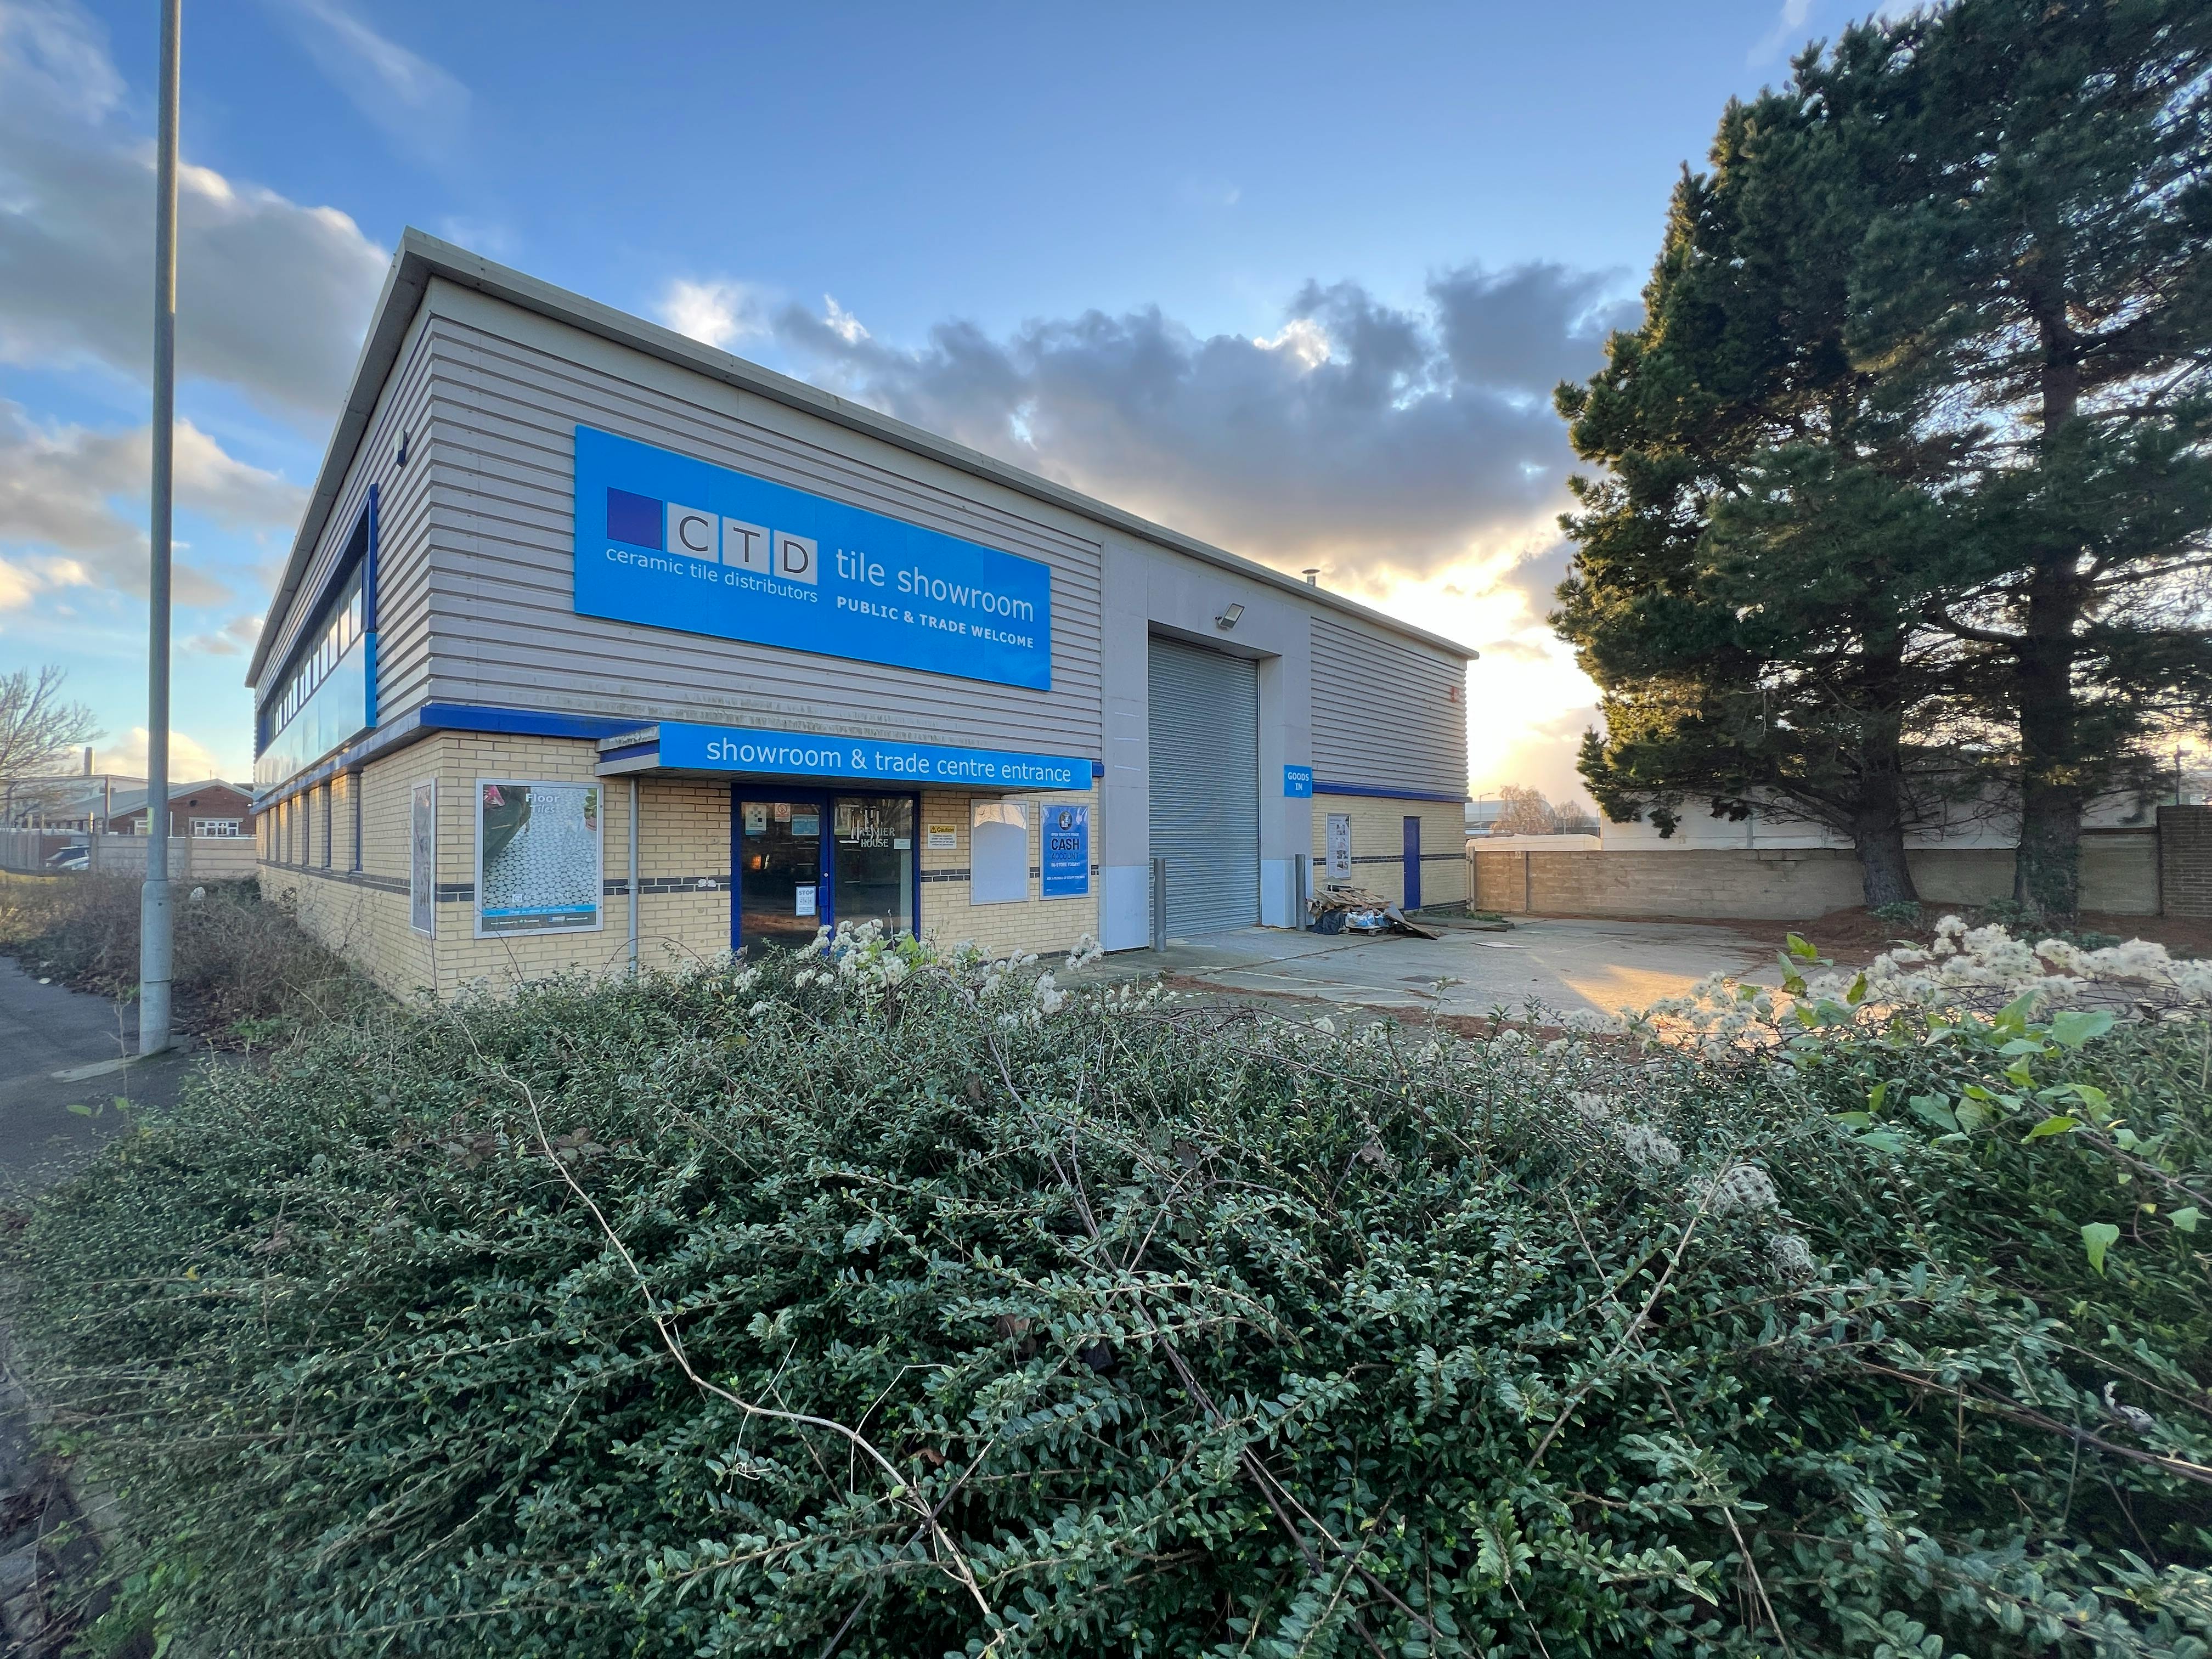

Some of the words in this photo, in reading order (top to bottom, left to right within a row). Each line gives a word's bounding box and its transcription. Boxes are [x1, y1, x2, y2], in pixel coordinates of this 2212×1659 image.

[679, 516, 809, 573] CTD
[606, 548, 684, 575] ceramic
[690, 563, 718, 582] tile
[725, 571, 818, 603] distributors
[836, 549, 885, 586] tile
[898, 566, 1034, 622] showroom
[837, 596, 898, 620] PUBLIC
[904, 610, 915, 624] &
[919, 613, 966, 635] TRADE
[971, 624, 1034, 648] WELCOME
[707, 737, 841, 768] showroom
[851, 748, 868, 770] &
[875, 751, 929, 774] trade
[937, 759, 995, 777] centre
[1002, 763, 1071, 782] entrance
[1288, 771, 1310, 781] GOODS
[1295, 782, 1303, 791] IN
[526, 793, 560, 803] Floor
[529, 804, 555, 813] Tiles
[861, 838, 889, 848] HOUSE
[1052, 838, 1080, 850] CASH
